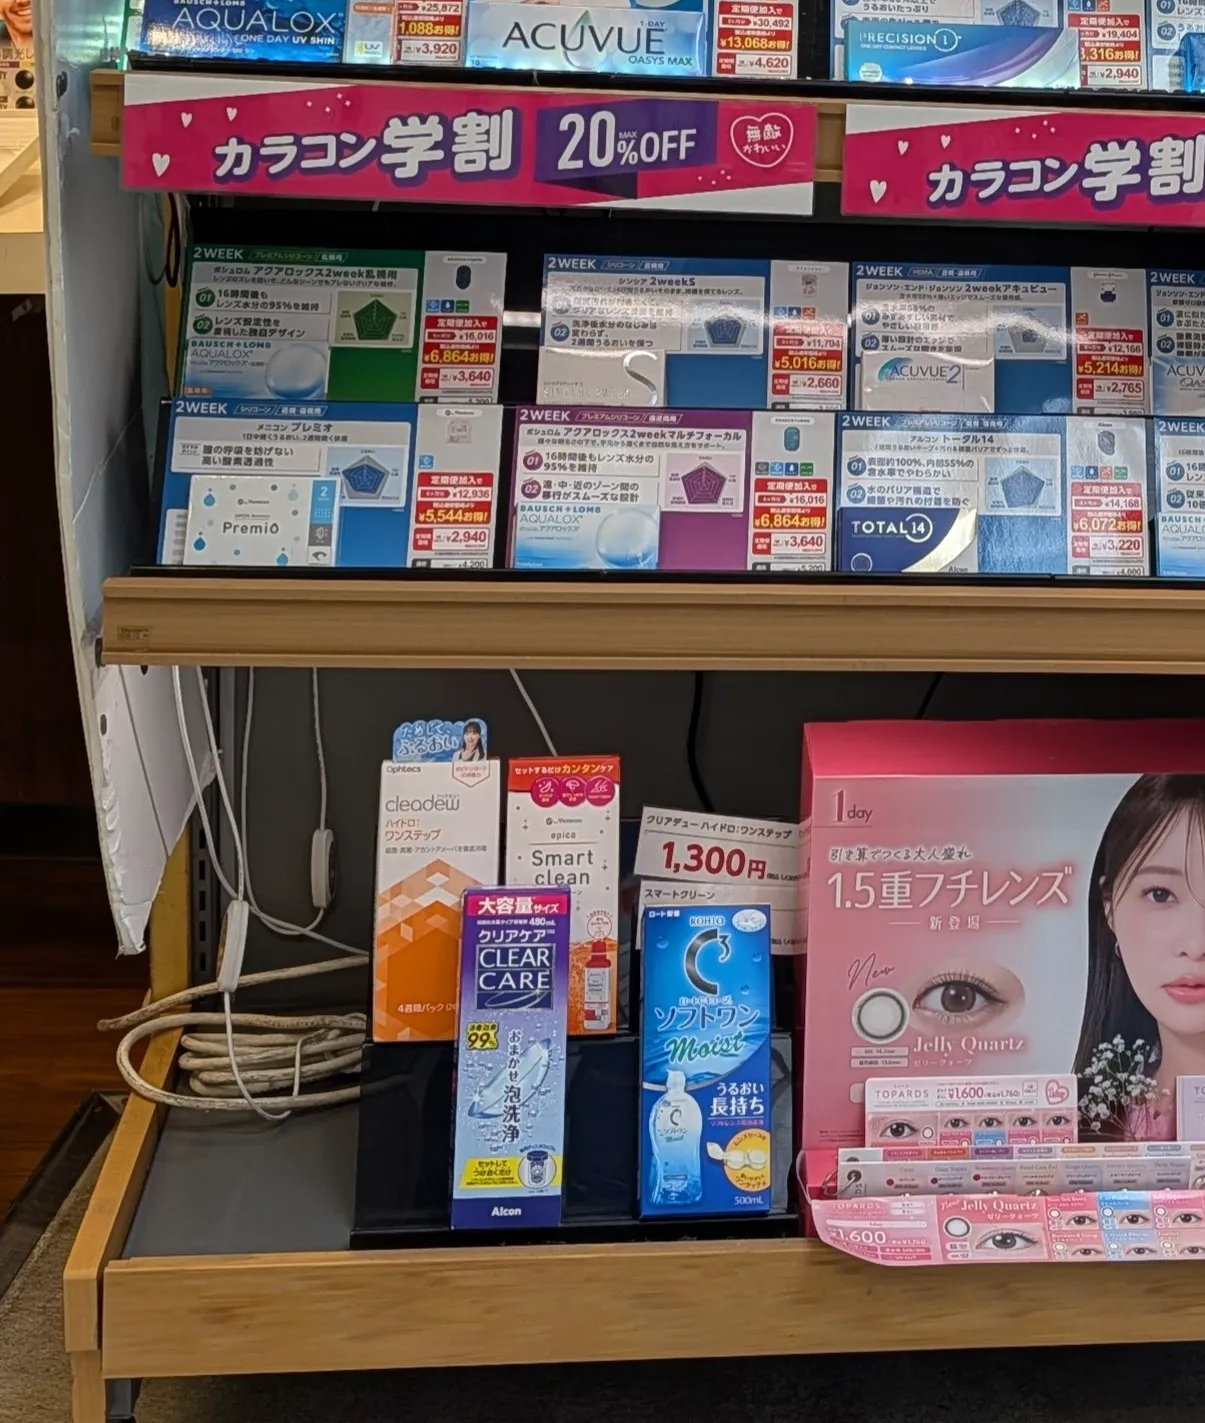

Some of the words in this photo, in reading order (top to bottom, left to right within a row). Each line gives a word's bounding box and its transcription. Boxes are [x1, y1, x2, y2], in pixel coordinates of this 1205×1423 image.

[172, 6, 337, 34] AQUALOX
[502, 21, 665, 56] ACUVUE
[628, 54, 664, 66] OASYS
[667, 56, 693, 67] MAX
[213, 108, 515, 179] カラコン学割
[193, 247, 244, 260] 2WEEK
[548, 258, 597, 270] 2WEEK
[650, 276, 696, 287] 2weekS
[191, 348, 251, 359] AQUALOX
[890, 364, 950, 378] ACUVUE
[291, 421, 333, 434] プレミオ
[526, 428, 561, 437] ボシュロム
[1159, 421, 1205, 432] 2WEEK
[942, 433, 994, 444] トータル14
[519, 514, 580, 525] AQUALOX
[222, 522, 279, 535] Premio
[851, 521, 908, 534] TOTAL
[386, 766, 421, 774] Ophtecs
[514, 764, 614, 774] セットするだけカンタンケア
[385, 794, 459, 812] cleadew
[646, 815, 698, 828] クリアデュー
[701, 822, 792, 839] ハイドロ:ワンステップ
[385, 828, 441, 841] ワンステップ
[550, 830, 577, 841] epica
[531, 850, 594, 867] Smart
[663, 841, 766, 880] 1,300円
[829, 846, 972, 862] 引き算でつくる大人盛れ
[534, 869, 590, 886] clean
[645, 889, 715, 900] スマートクリーン
[827, 866, 1073, 911] 1.5重フチレンズ
[478, 897, 559, 915] 大容量サイズ
[929, 915, 981, 931] 新登場
[478, 929, 546, 943] クリアケア
[479, 948, 550, 968] CLEAR
[848, 953, 895, 991] New
[479, 971, 550, 990] CARE
[656, 1007, 759, 1030] ソフトワン
[666, 1030, 745, 1063] Moist
[913, 1036, 954, 1058] Jelly
[961, 1036, 1025, 1053] Quartz
[501, 1030, 522, 1143] おまかせ泡洗浄
[716, 1082, 765, 1095] うるおい
[875, 1089, 929, 1099] TOPARDS
[709, 1095, 765, 1116] 長持ち
[734, 1195, 765, 1206] 500mL
[961, 1200, 990, 1212] Jelly
[992, 1200, 1038, 1212] Quartz
[491, 1206, 522, 1217] Alcon
